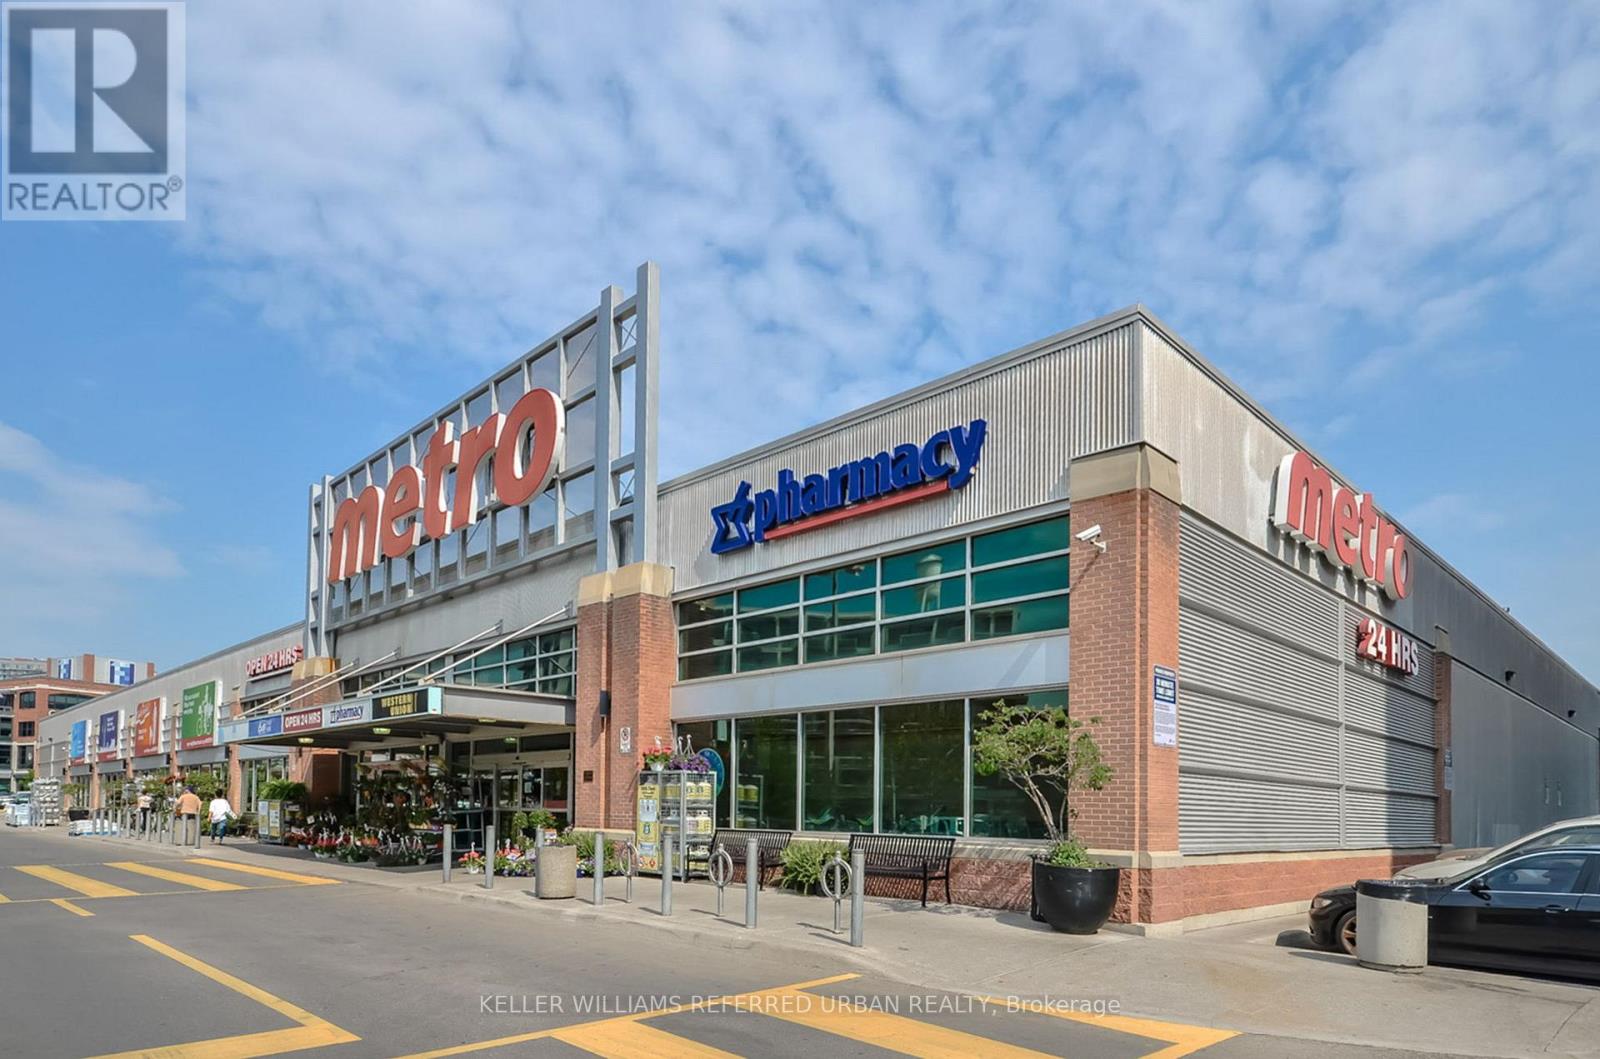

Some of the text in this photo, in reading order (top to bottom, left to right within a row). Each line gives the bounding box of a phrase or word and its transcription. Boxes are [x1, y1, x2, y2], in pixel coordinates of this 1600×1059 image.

[328, 387, 565, 583] metro
[753, 418, 987, 544] pharmacy
[1276, 451, 1411, 600] metro
[245, 656, 268, 676] OPEN
[279, 647, 300, 668] HRS
[1361, 617, 1419, 676] 24 HRS
[285, 714, 300, 728] OPEN
[300, 712, 308, 726] 24
[308, 711, 321, 724] HRS
[336, 705, 364, 720] pharmacy
